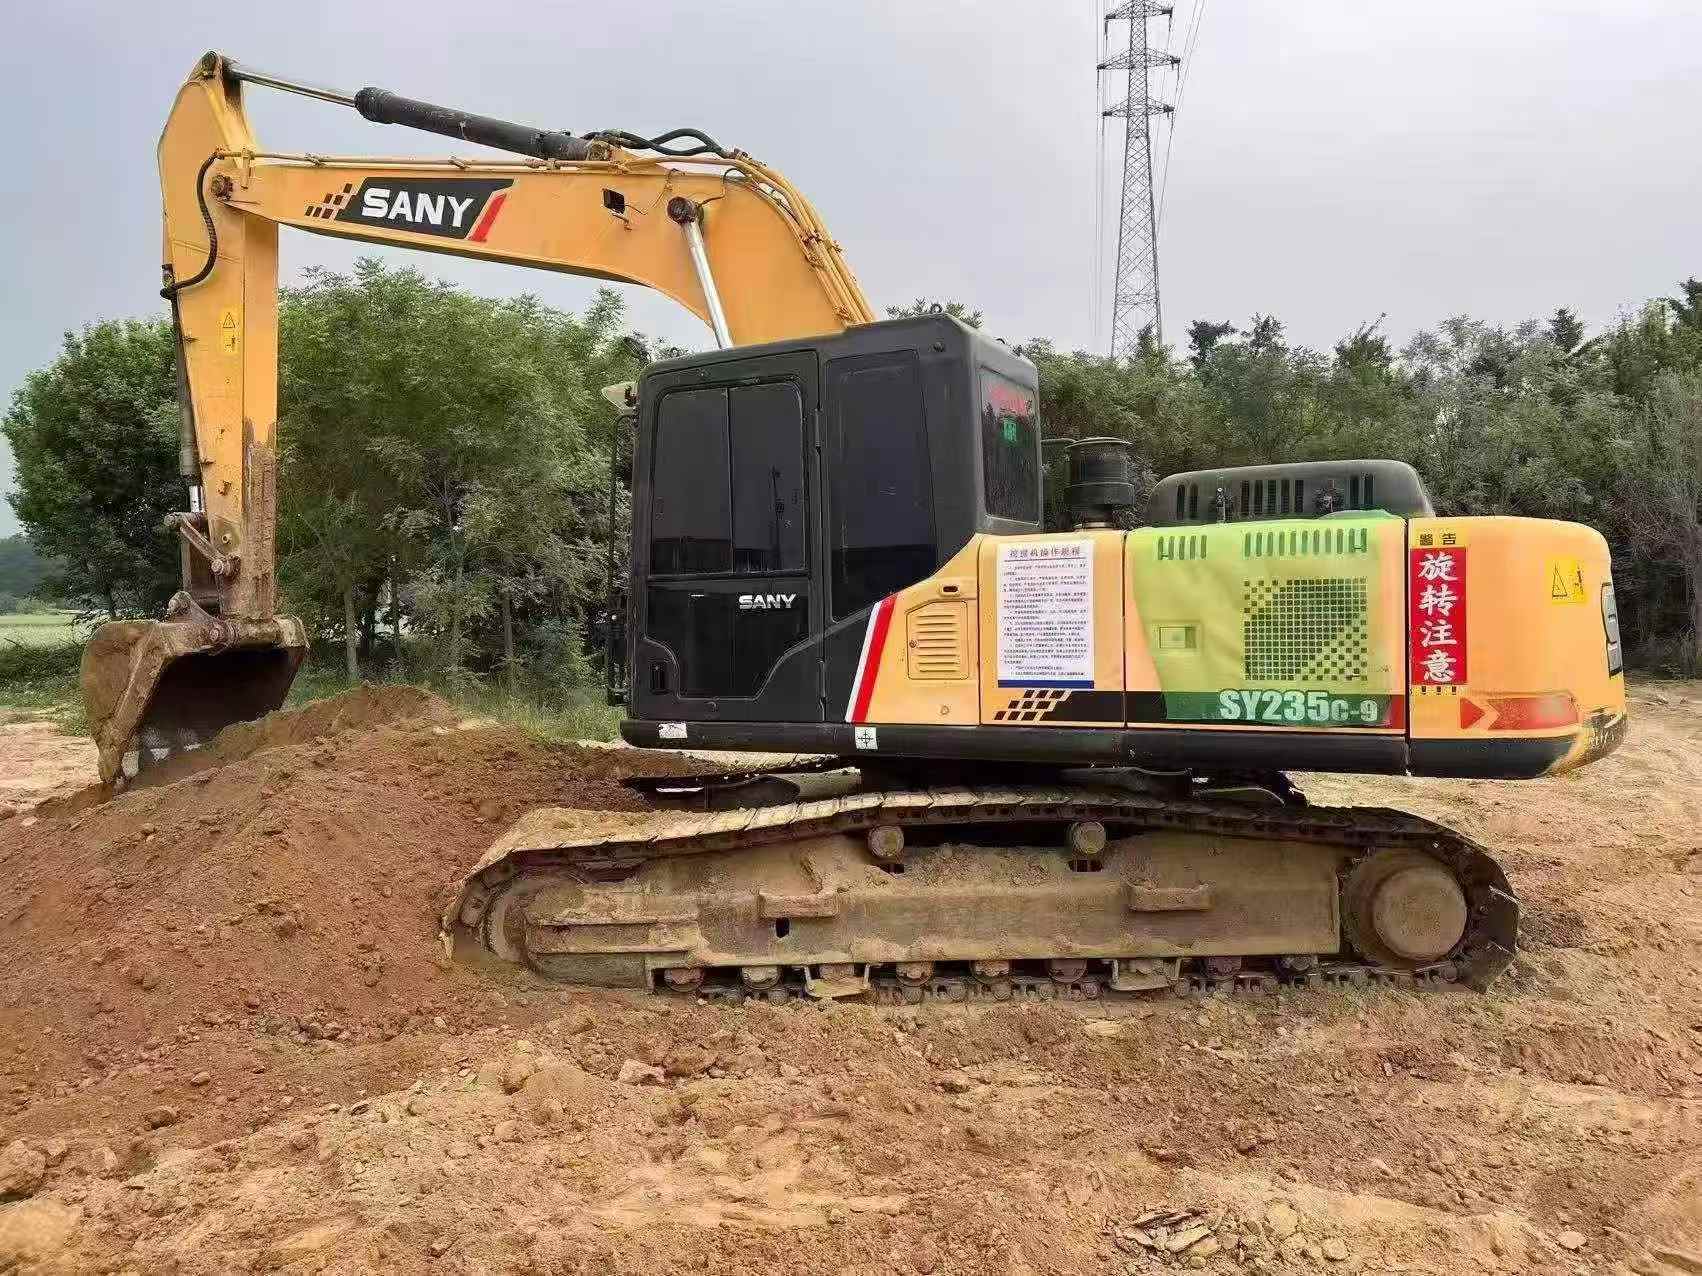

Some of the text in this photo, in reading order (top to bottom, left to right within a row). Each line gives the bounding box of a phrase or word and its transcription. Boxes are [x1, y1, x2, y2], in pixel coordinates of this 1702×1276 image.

[361, 187, 475, 228] SANY
[738, 594, 797, 609] SANY
[1418, 551, 1458, 682] 旋转注意
